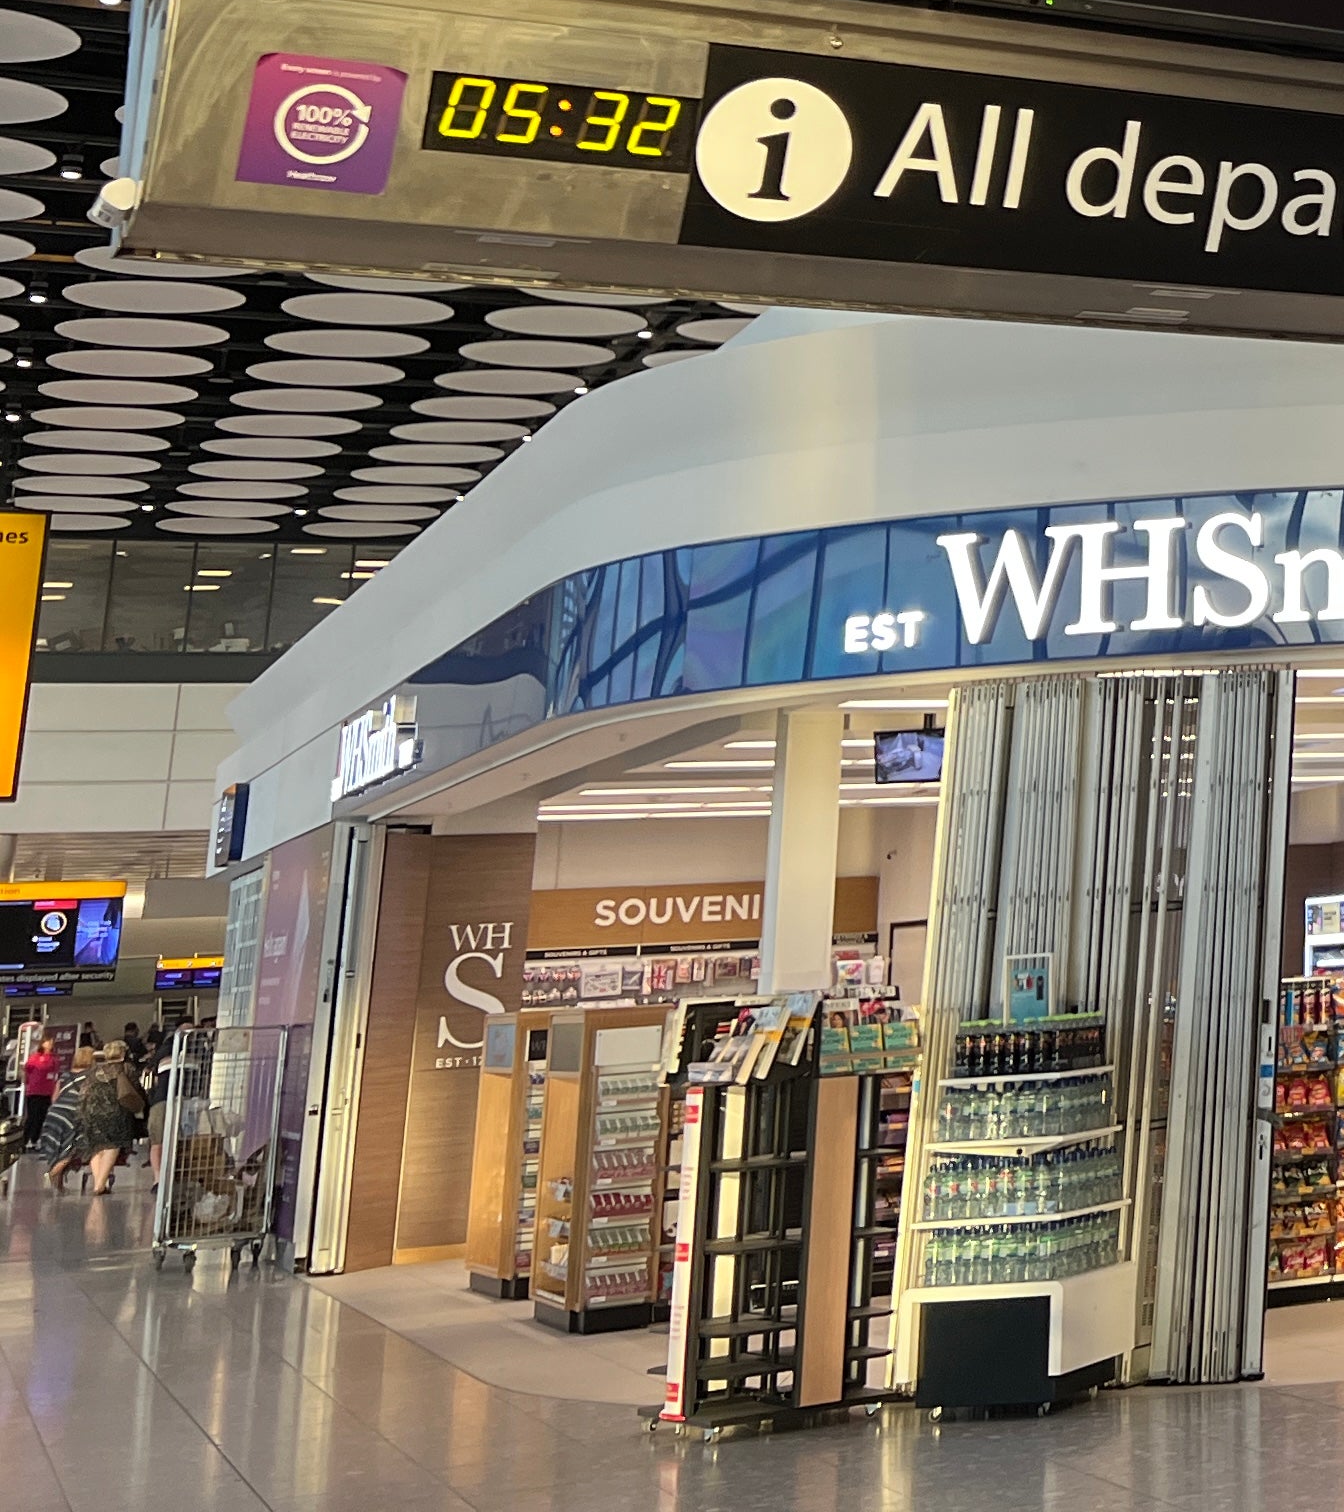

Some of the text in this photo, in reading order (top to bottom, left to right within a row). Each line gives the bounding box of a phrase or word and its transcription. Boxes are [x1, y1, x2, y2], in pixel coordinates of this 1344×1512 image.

[296, 104, 353, 127] 100%
[437, 76, 682, 157] 05:32
[873, 101, 1034, 210] All
[841, 609, 926, 655] EST
[594, 893, 761, 928] SOUVENI
[449, 922, 514, 951] WH
[437, 952, 506, 1049] S
[435, 1056, 462, 1069] EST
